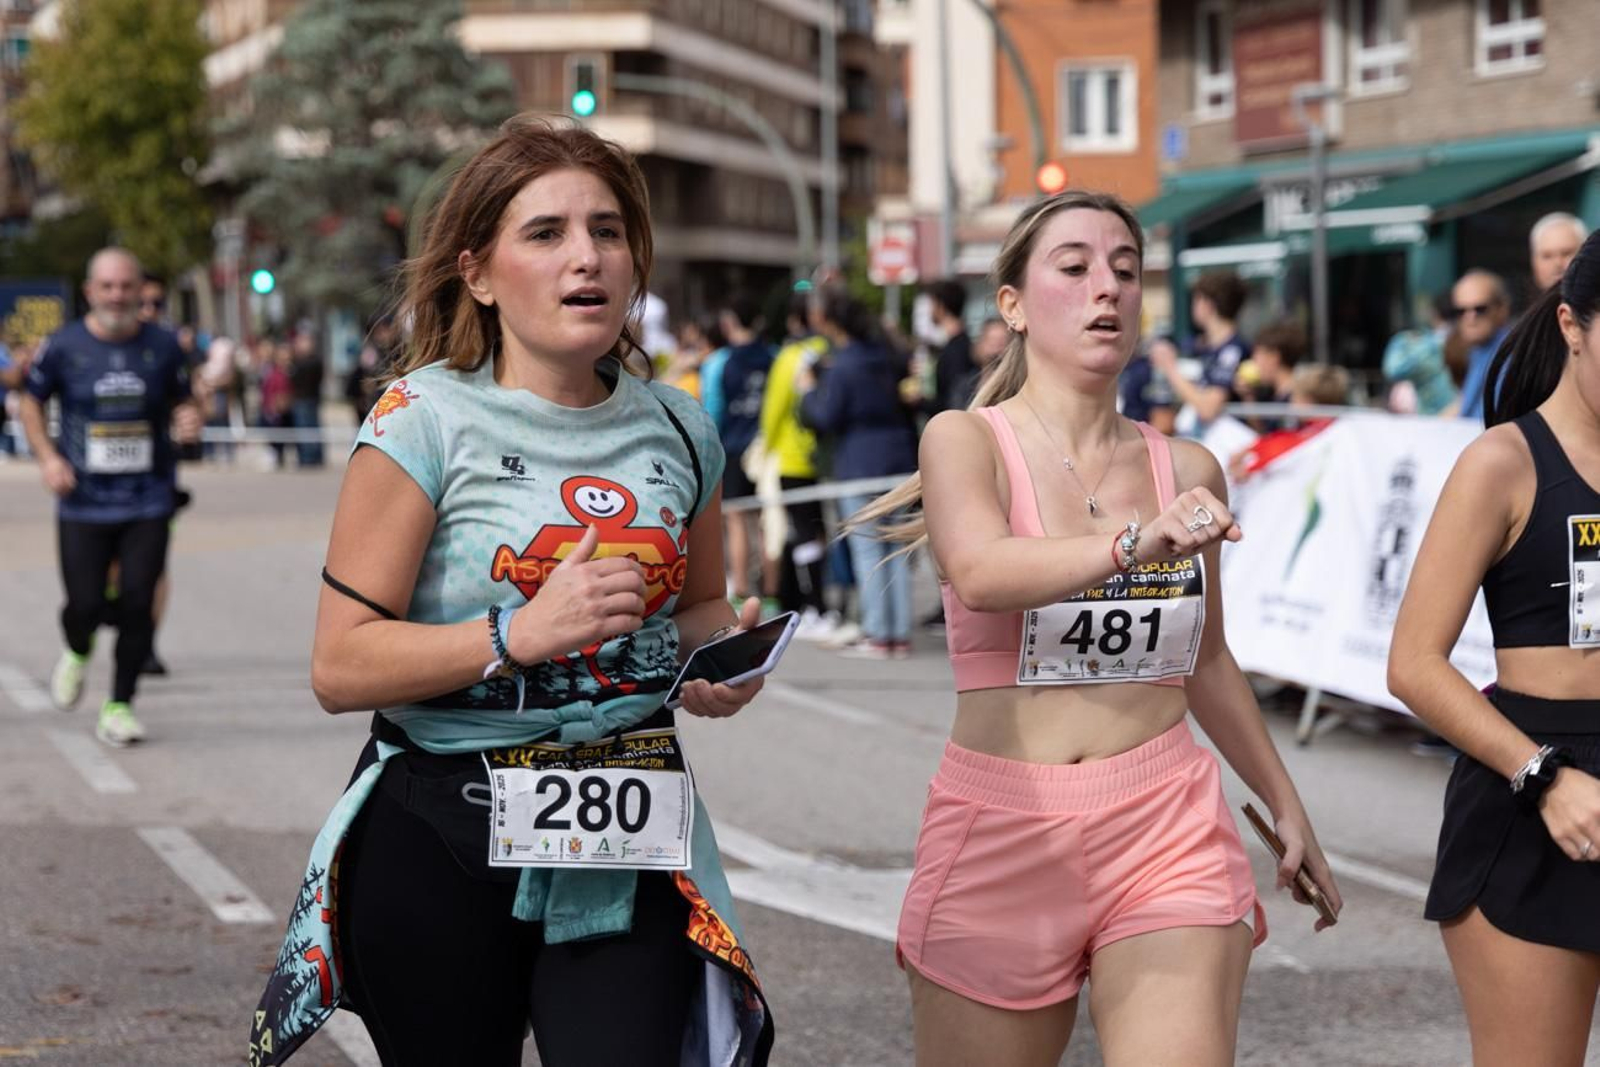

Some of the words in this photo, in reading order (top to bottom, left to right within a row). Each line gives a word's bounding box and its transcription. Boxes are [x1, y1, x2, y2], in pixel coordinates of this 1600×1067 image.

[1131, 569, 1196, 583] caminata
[1114, 589, 1128, 599] LA
[1060, 607, 1162, 656] 481
[533, 774, 652, 834] 280
